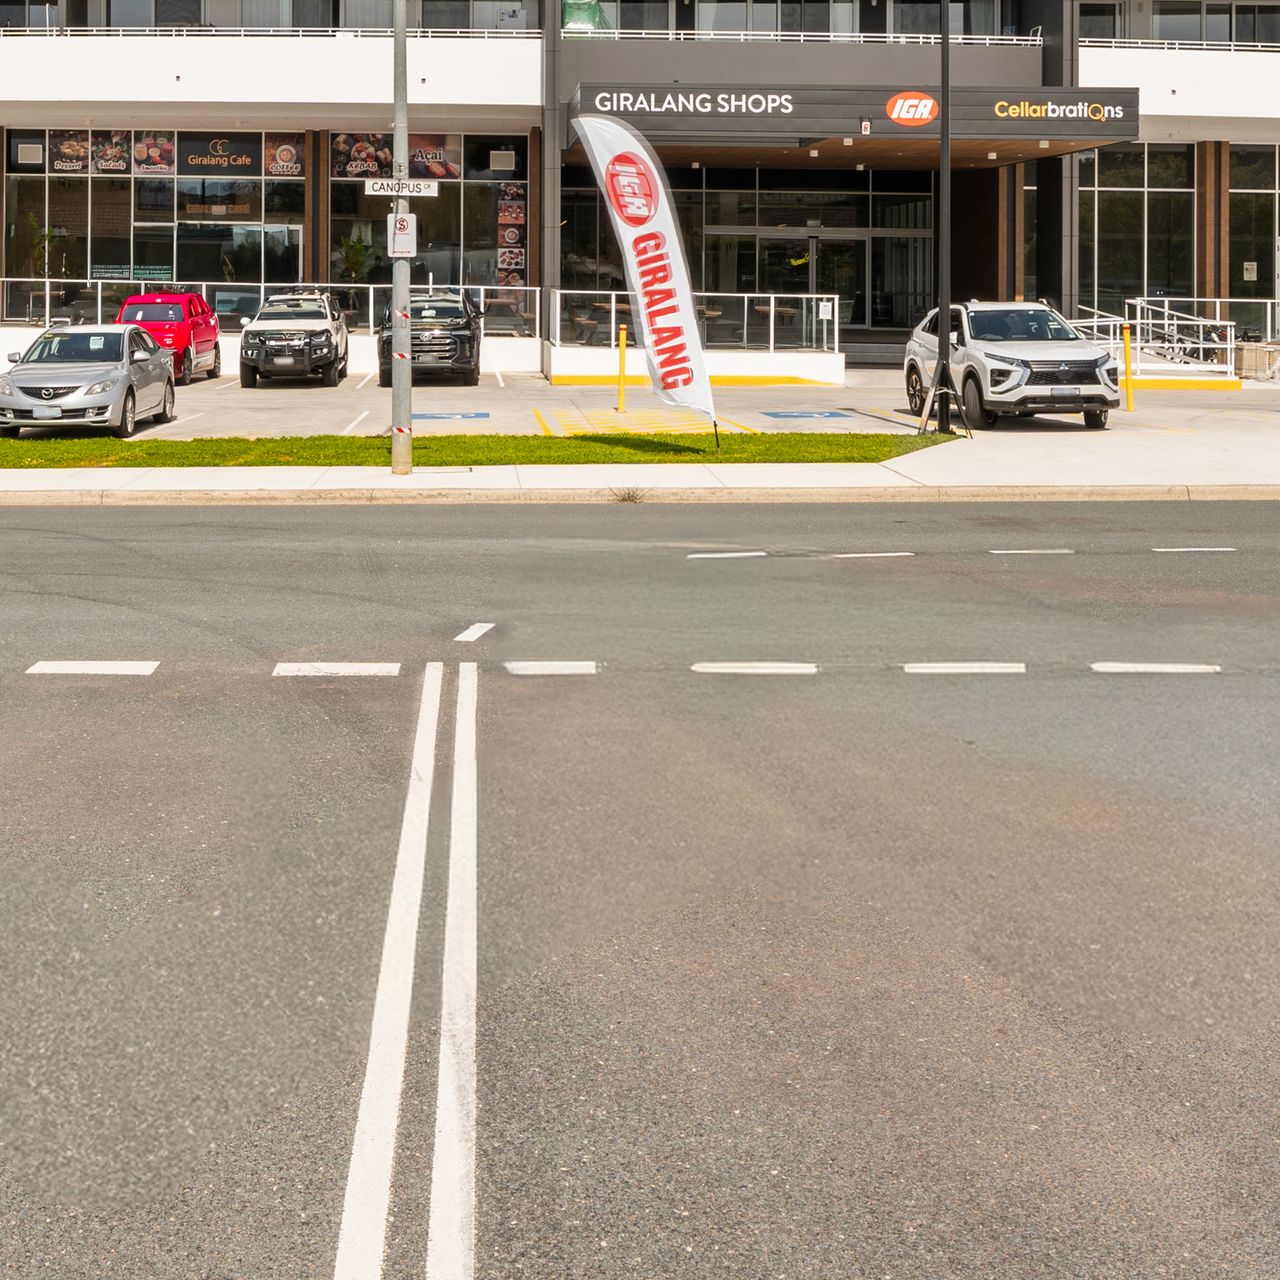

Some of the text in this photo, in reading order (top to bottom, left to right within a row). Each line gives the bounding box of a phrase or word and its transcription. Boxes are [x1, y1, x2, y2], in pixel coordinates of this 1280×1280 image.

[595, 92, 793, 114] GIRALANG SHOPS
[890, 98, 934, 119] IGA
[994, 101, 1123, 121] Cellarbrations
[188, 154, 252, 167] Giralang Cafe
[415, 148, 443, 165] Açai
[54, 161, 82, 170] Dessert
[97, 161, 126, 170] Salads
[372, 182, 421, 193] CANOPUS
[632, 230, 694, 392] GIRALANG
